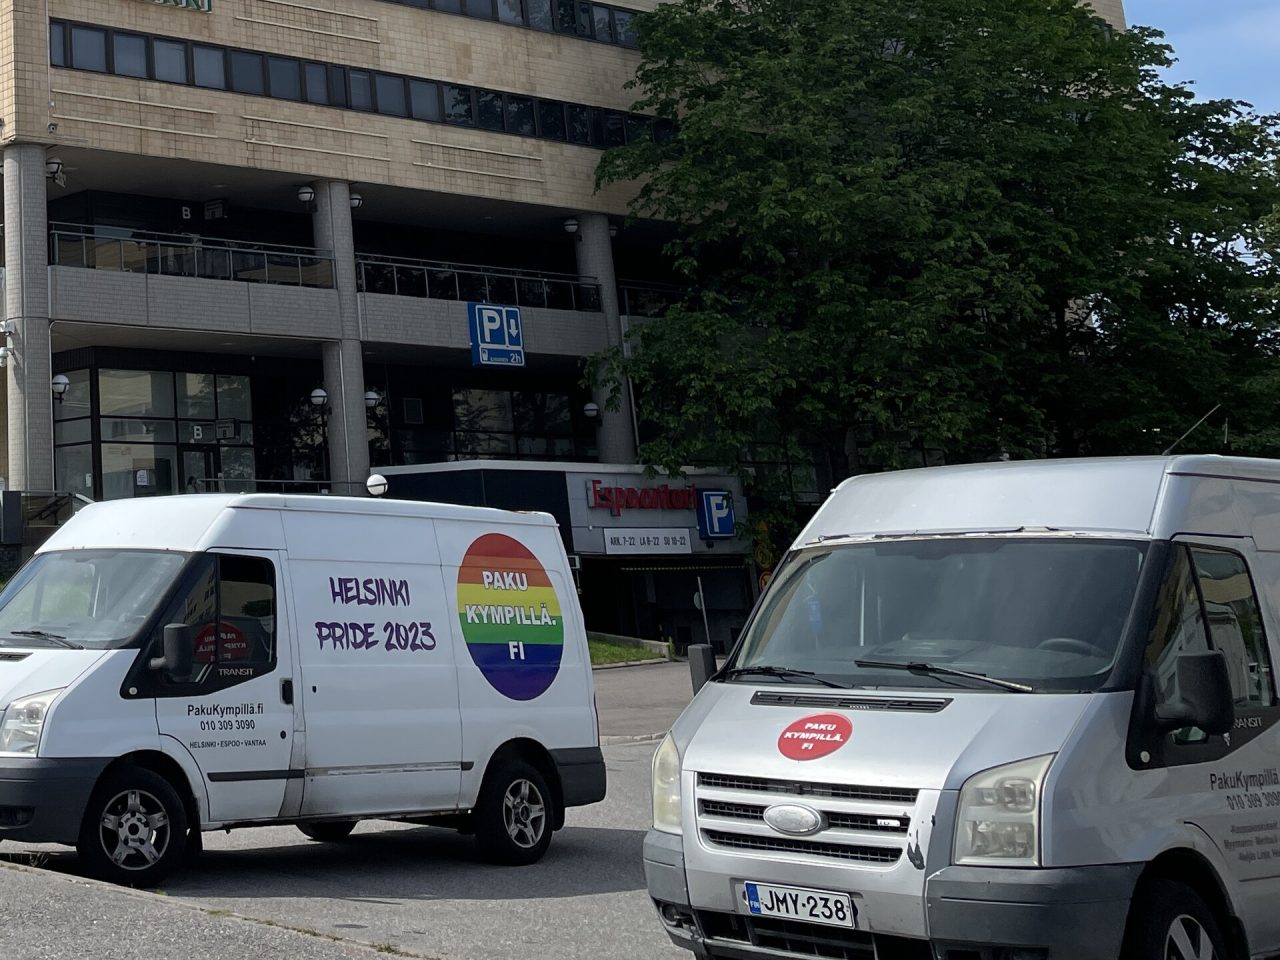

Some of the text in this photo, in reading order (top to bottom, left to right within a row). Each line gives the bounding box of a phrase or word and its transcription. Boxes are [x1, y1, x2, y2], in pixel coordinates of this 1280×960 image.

[182, 206, 191, 219] B
[482, 309, 501, 342] P
[193, 425, 203, 439] B
[591, 480, 698, 517] Espoontori
[710, 495, 729, 533] P
[482, 571, 528, 591] PAKU
[329, 577, 410, 607] HELSINKI
[465, 603, 557, 626] KYMPILLÄ.
[315, 621, 437, 652] PRIDE 2023
[508, 641, 525, 660] FI
[218, 668, 254, 676] TRANSIT
[187, 703, 264, 719] PakuKympillä.fi
[200, 719, 256, 731] 010 309 3090
[804, 722, 837, 731] PAKU
[1232, 717, 1263, 729] RANSIT
[189, 739, 267, 749] HELSINKI ESPOO VANTAA
[783, 731, 844, 742] KYMPILLÄ.
[801, 742, 814, 750] FI
[1226, 795, 1245, 811] 010
[1244, 793, 1263, 809] 309
[764, 890, 847, 922] JMY-238
